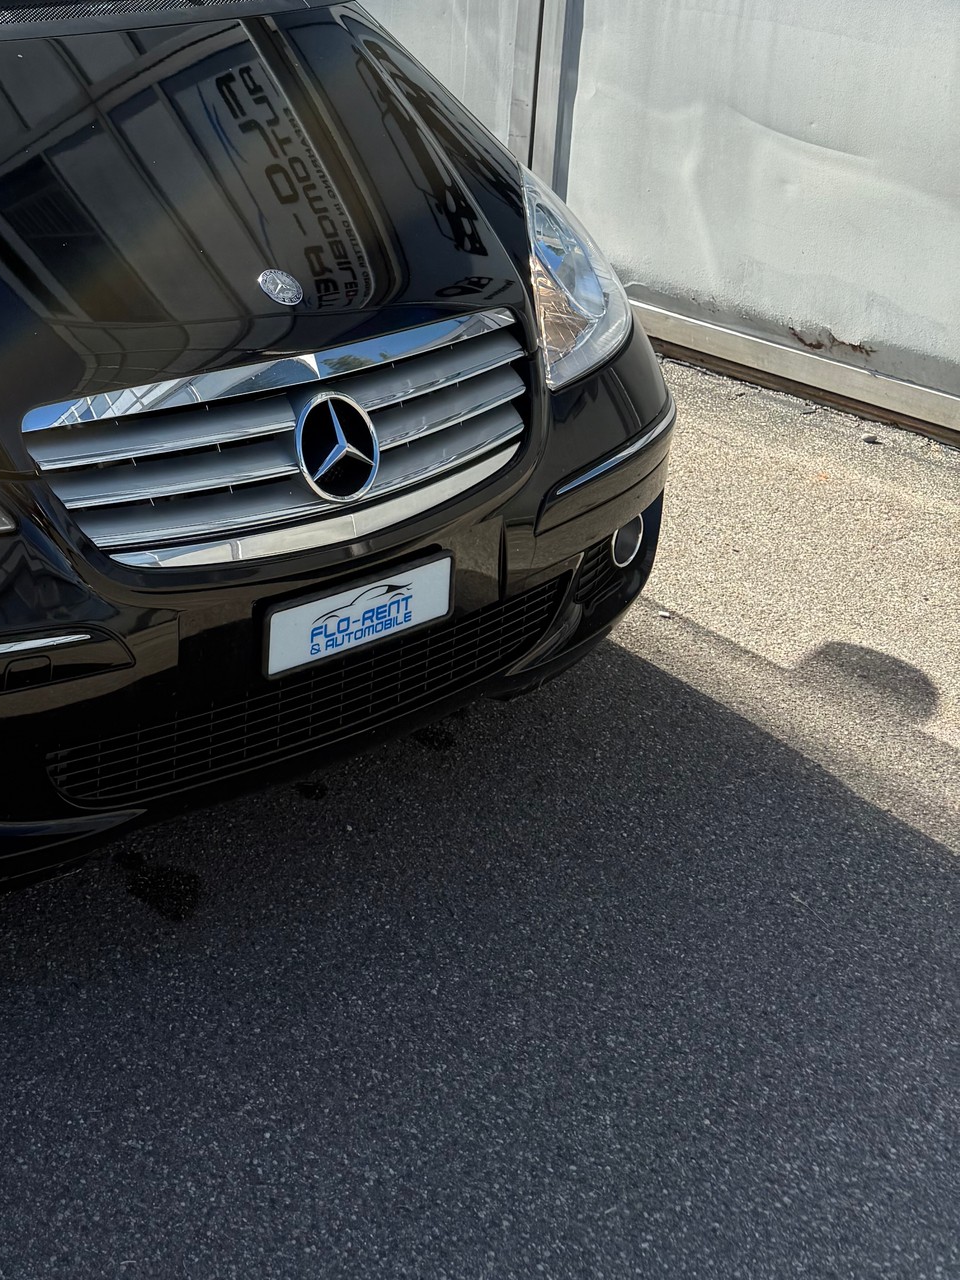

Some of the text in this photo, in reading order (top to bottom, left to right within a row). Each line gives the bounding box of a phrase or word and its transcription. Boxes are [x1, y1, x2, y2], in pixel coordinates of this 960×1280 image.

[310, 595, 413, 644] FLO-RENT
[310, 611, 412, 655] & AUTOMOBILE
